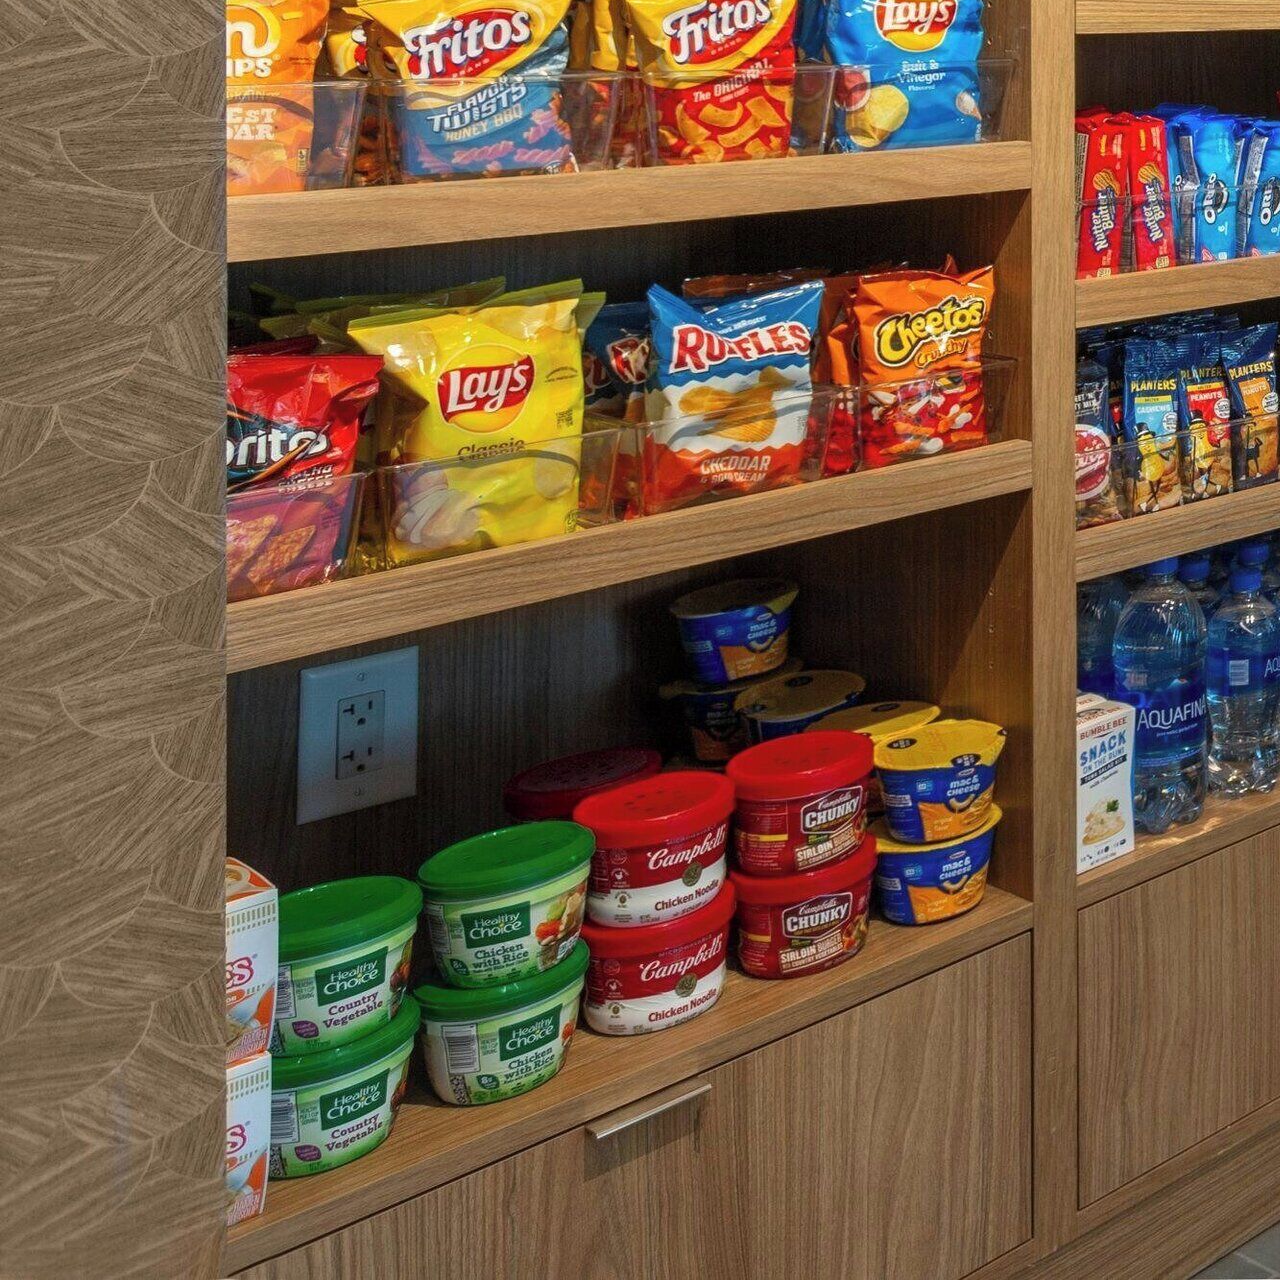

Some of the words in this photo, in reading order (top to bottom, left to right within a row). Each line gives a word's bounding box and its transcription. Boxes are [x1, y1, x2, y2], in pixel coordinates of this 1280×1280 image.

[403, 10, 531, 80] Fritos
[692, 91, 711, 103] The
[713, 58, 770, 97] ORIGINAL
[899, 71, 946, 85] Vinegar
[427, 82, 529, 133] TWISTS
[444, 122, 490, 142] HONEY
[494, 104, 524, 126] BBQ
[1143, 206, 1164, 241] Nutter
[876, 298, 984, 363] Cheetos
[672, 324, 811, 371] RUFFLES
[1228, 361, 1274, 380] PLANTERS
[446, 360, 531, 413] Lay's
[1131, 379, 1177, 392] PLANTERS
[1190, 390, 1223, 401] PEANUTS
[457, 437, 526, 461] Classic
[700, 455, 771, 475] CHEDDAR
[1137, 695, 1207, 731] AQUAFINA
[1080, 722, 1111, 740] BUMBLE
[1112, 716, 1128, 729] BEE
[1080, 729, 1127, 767] SNACK
[1082, 765, 1092, 775] ON
[1094, 756, 1107, 769] THE
[804, 796, 860, 829] CHUNKY
[817, 790, 852, 811] Campbell's
[647, 824, 726, 870] Campbell's
[796, 841, 834, 863] SIRLOIN
[654, 893, 694, 912] Chicken
[694, 880, 721, 900] Noodle
[469, 920, 523, 940] Choice
[474, 911, 521, 929] Healthy
[786, 903, 849, 934] CHUNKY
[472, 957, 501, 970] with
[502, 949, 530, 965] Rice
[474, 942, 525, 960] Chicken
[639, 932, 724, 982] Campbell's
[780, 944, 817, 963] SIRLOIN
[323, 970, 381, 996] Choice
[330, 959, 380, 983] Healthy
[323, 1000, 385, 1029] Vegetable
[328, 992, 380, 1017] Country
[648, 1001, 689, 1023] Chicken
[689, 987, 718, 1009] Noodle
[506, 1025, 555, 1051] Choice
[512, 1015, 554, 1040] Healthy
[504, 1065, 531, 1081] with
[532, 1054, 556, 1073] Rice
[508, 1046, 553, 1070] Chicken
[326, 1092, 382, 1121] Choice
[333, 1081, 380, 1108] Healthy
[325, 1120, 384, 1153] Vegetable
[330, 1113, 381, 1140] Country
